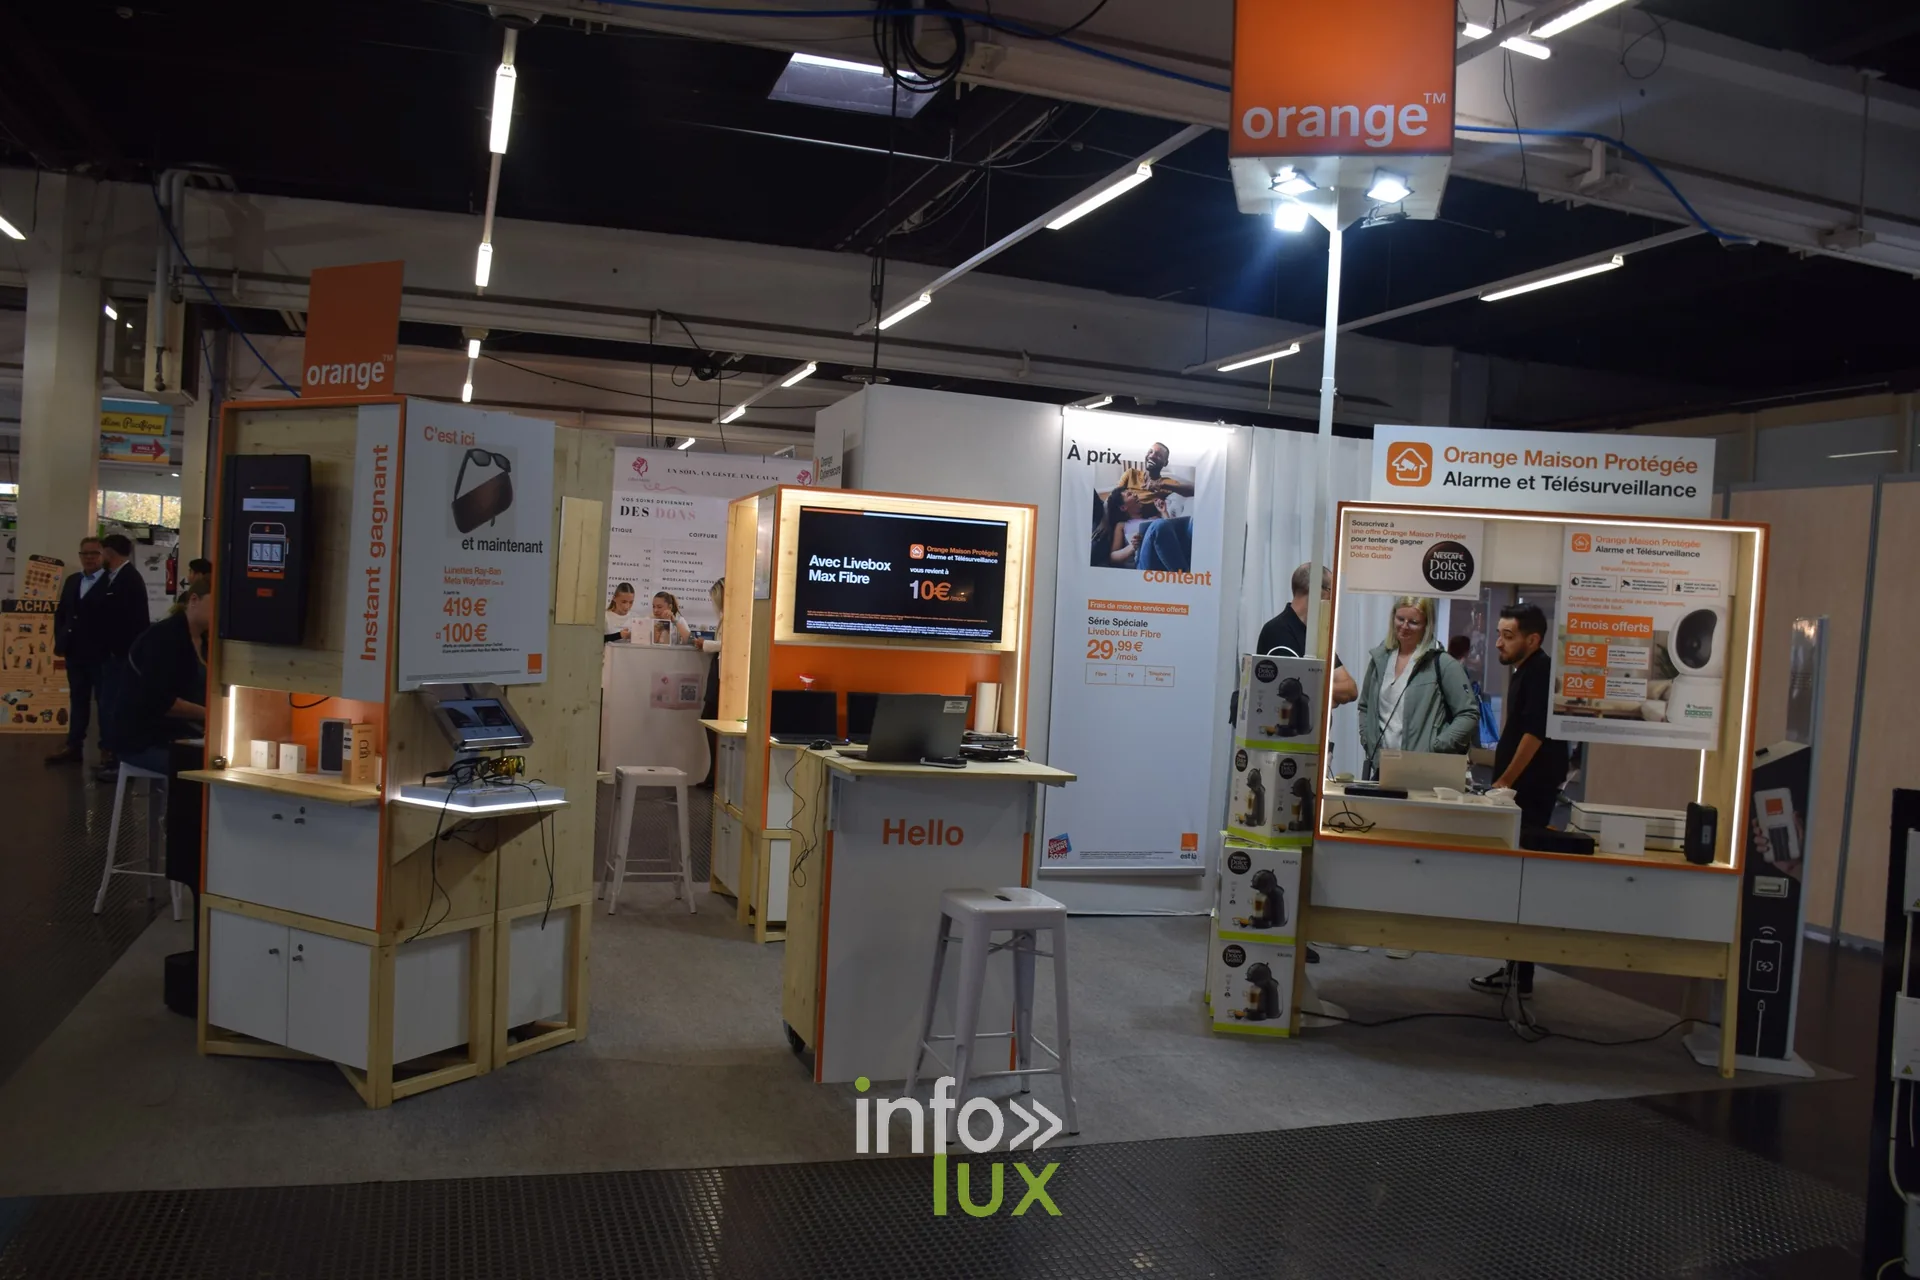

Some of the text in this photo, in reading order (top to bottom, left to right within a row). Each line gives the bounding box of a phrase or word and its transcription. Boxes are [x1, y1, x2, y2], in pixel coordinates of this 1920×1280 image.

[1242, 103, 1428, 147] orange
[307, 361, 385, 390] orange
[424, 425, 475, 446] C'est ici
[1066, 440, 1123, 466] À prix
[1444, 446, 1699, 477] Orange Maison Protégée
[1443, 470, 1698, 499] Alarme et Télésurveillance
[620, 504, 697, 520] DES DONS
[1352, 519, 1388, 527] Souscrivez
[1382, 529, 1408, 537] Orange
[1409, 530, 1434, 538] Maison
[1435, 532, 1467, 540] Protégée
[1595, 534, 1701, 550] Orange Maison Protégée
[360, 444, 389, 662] Instant gagnant
[461, 537, 543, 553] et maintenant
[926, 545, 949, 554] Orange
[972, 548, 999, 556] Protégée
[1595, 544, 1624, 554] Alarme
[1636, 547, 1701, 558] Télésurveillance
[809, 554, 892, 572] Avec Livebox
[926, 553, 947, 561] Alarme
[955, 555, 998, 564] Télésurveillance
[1429, 559, 1467, 572] Dolce
[444, 565, 502, 577] Lunettes Ray-Ban
[809, 569, 870, 585] Max Fibre
[925, 567, 944, 575] revient
[1143, 569, 1212, 586] content
[1429, 570, 1467, 581] Gusto
[461, 577, 491, 587] Wayfarer
[909, 579, 952, 601] 10€
[1088, 616, 1148, 628] Série Spéciale
[1569, 618, 1650, 633] 2 mois offerts
[1088, 627, 1161, 639] Livebox Lite Fibre
[1116, 652, 1138, 661] /mois
[882, 817, 964, 846] Hello
